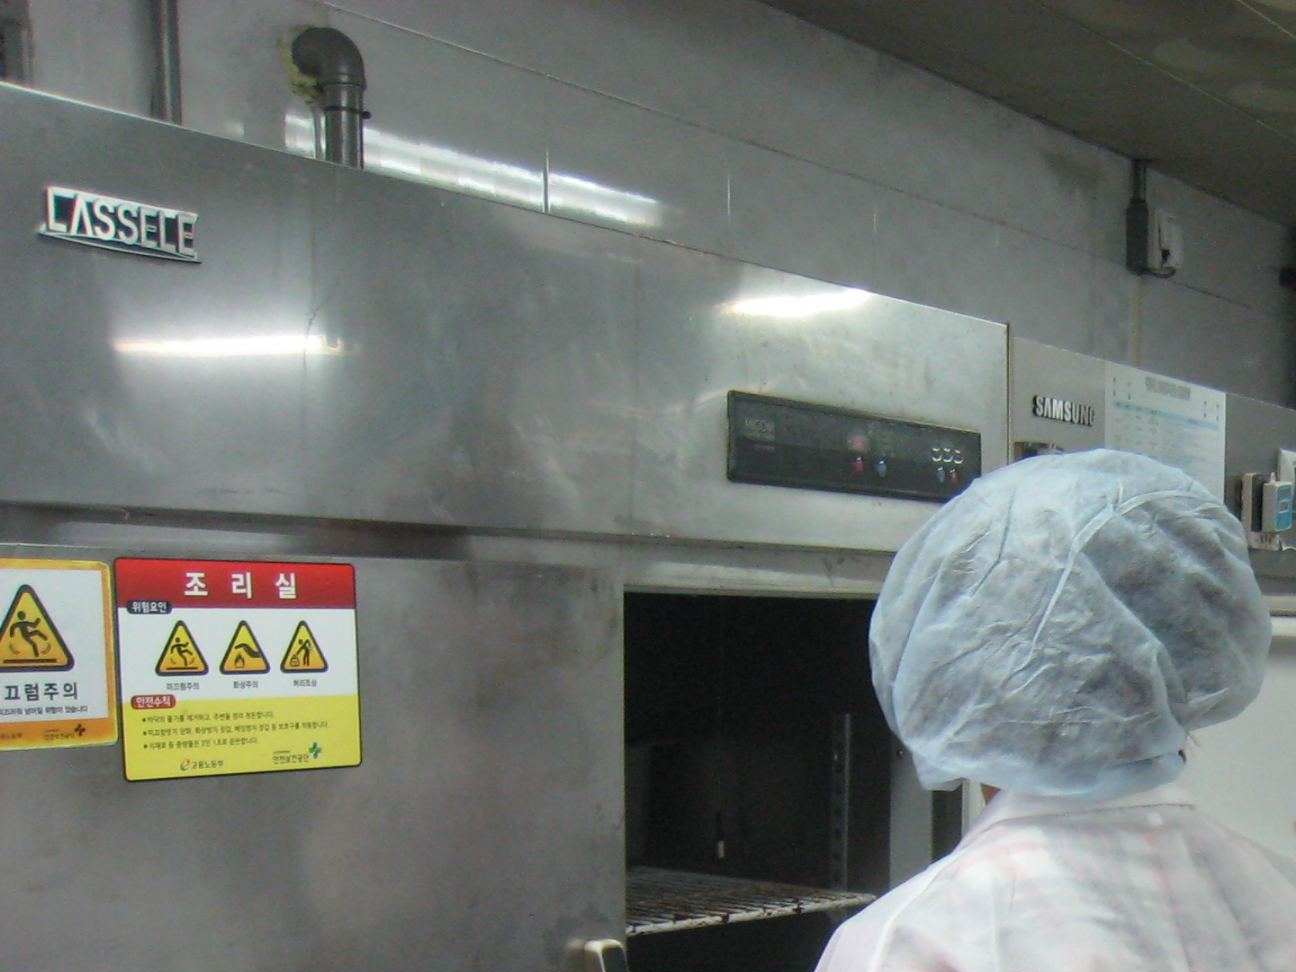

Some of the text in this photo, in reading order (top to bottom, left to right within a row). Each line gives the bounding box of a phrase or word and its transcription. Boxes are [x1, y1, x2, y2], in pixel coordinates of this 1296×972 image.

[46, 186, 199, 255] LASSELE
[131, 601, 167, 613] 위험요인
[136, 695, 171, 708] 안전수칙
